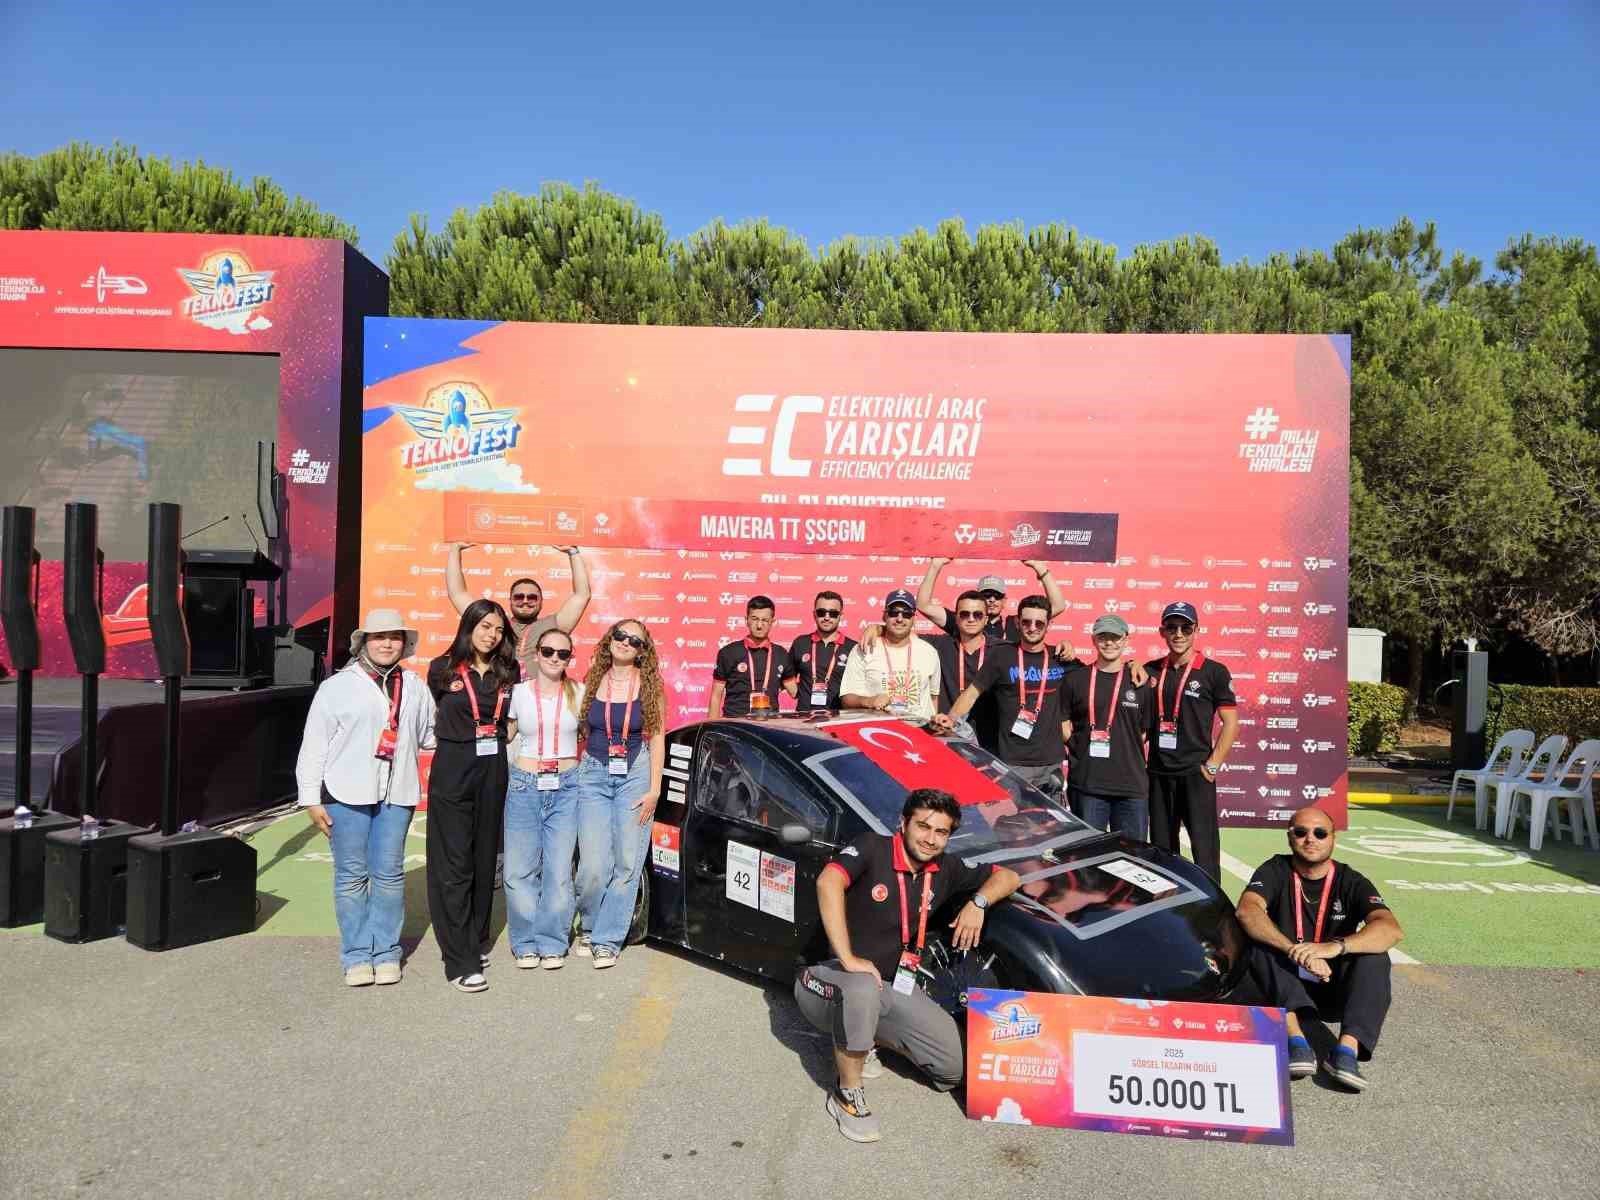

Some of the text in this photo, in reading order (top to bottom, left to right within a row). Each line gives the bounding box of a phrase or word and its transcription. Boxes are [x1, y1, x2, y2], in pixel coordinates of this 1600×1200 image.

[183, 283, 274, 316] TEKNOFEST
[827, 393, 987, 420] ELEKTRİKLİ ARAÇ
[400, 422, 522, 469] TEKNOFEST
[824, 421, 983, 460] YARIŞLARI
[1239, 443, 1317, 458] TEKNOLOJİ
[820, 459, 973, 481] EFFICIENCY CHALLENGE
[1248, 458, 1313, 472] HAMLESİ
[700, 515, 866, 545] MAVERA TT ŞSÇGM
[734, 871, 751, 891] 42
[991, 1022, 1042, 1041] TEKNOFEST
[1163, 1048, 1184, 1058] 2025
[1108, 1074, 1245, 1114] 50.000 TL
